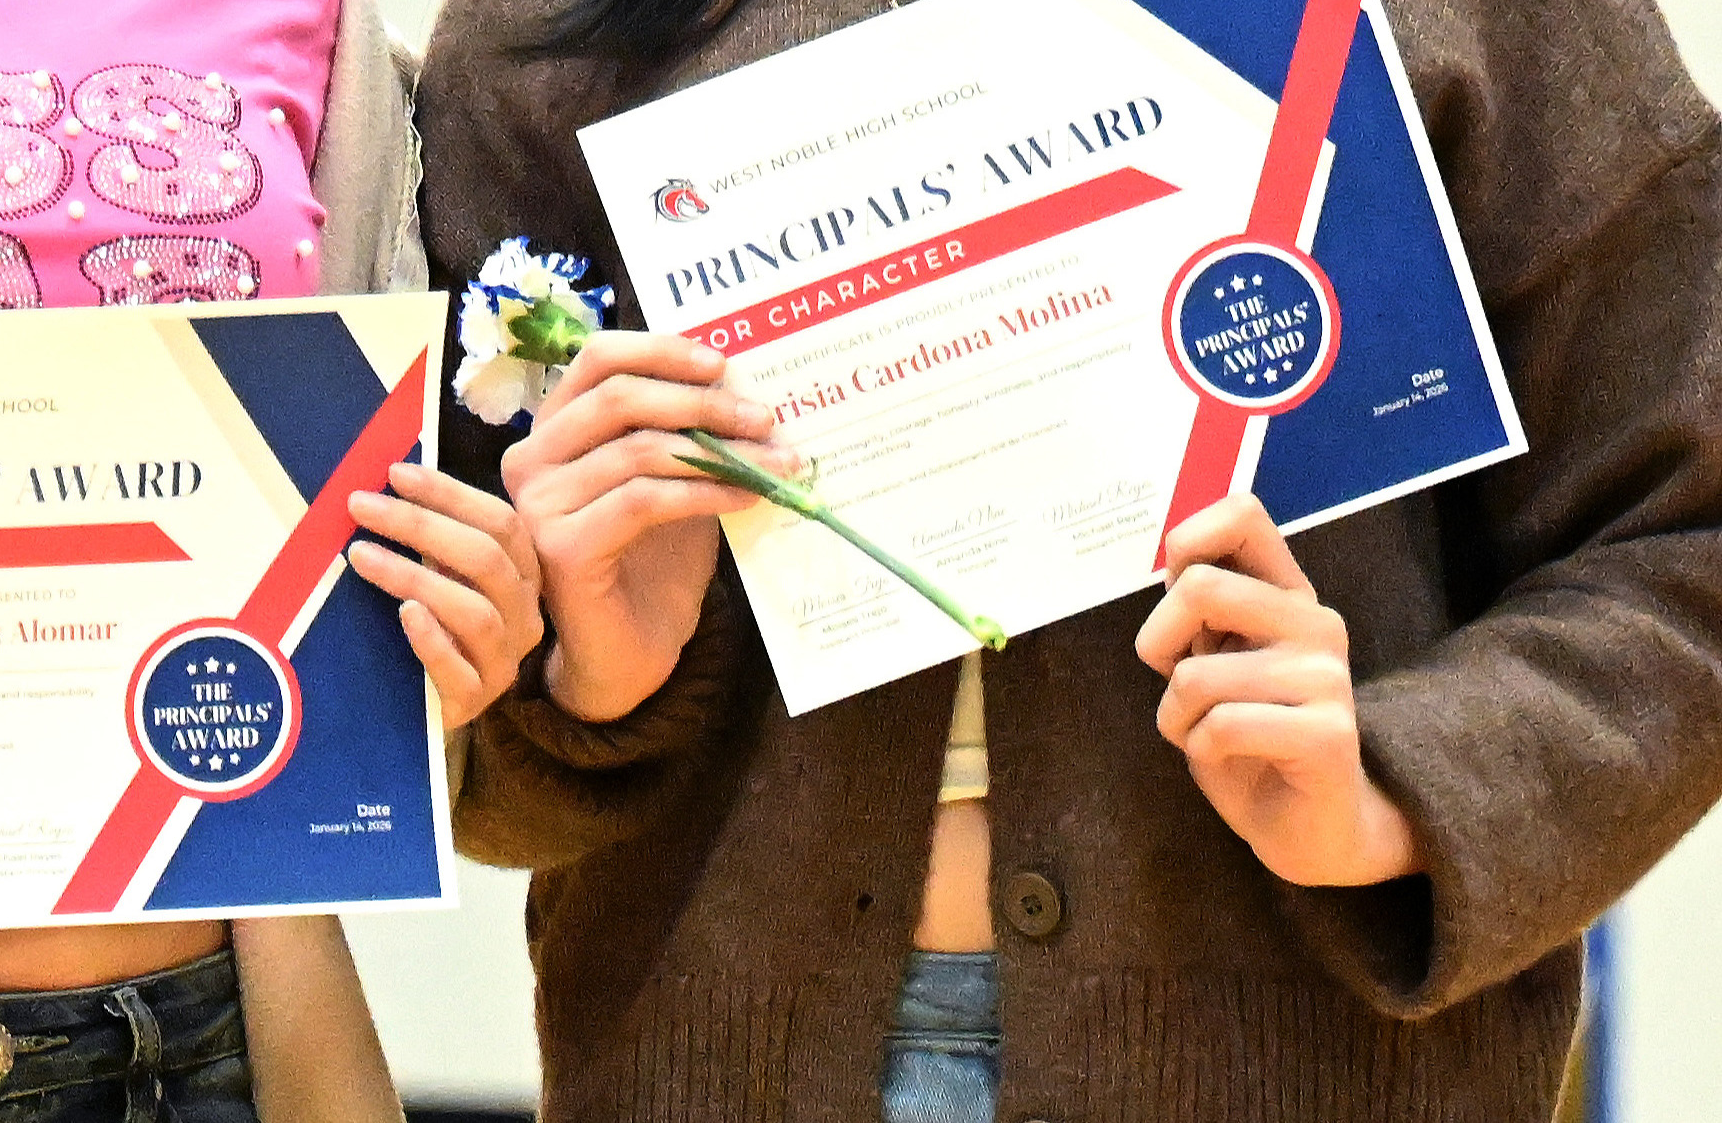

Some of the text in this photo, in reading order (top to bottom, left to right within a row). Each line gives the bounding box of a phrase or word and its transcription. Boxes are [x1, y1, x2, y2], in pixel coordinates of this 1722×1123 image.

[708, 78, 988, 195] WEST NOBLE HIGH SCHOOL
[970, 88, 1168, 196] AWARD
[765, 237, 967, 329] CHARACTER
[752, 251, 1080, 383] THE CERTIFICATE IS PROUDLY PRESENTED TO
[1225, 295, 1268, 323] THE
[763, 274, 1113, 428] risia Cardona Molina
[1222, 330, 1306, 376] AWARD
[1411, 367, 1445, 388] Date
[14, 456, 203, 505] AWARD
[58, 588, 76, 599] TO
[10, 614, 119, 645] Alomar
[192, 682, 233, 703] THE
[172, 727, 260, 751] AWARD
[356, 804, 391, 818] Date
[310, 822, 350, 835] January
